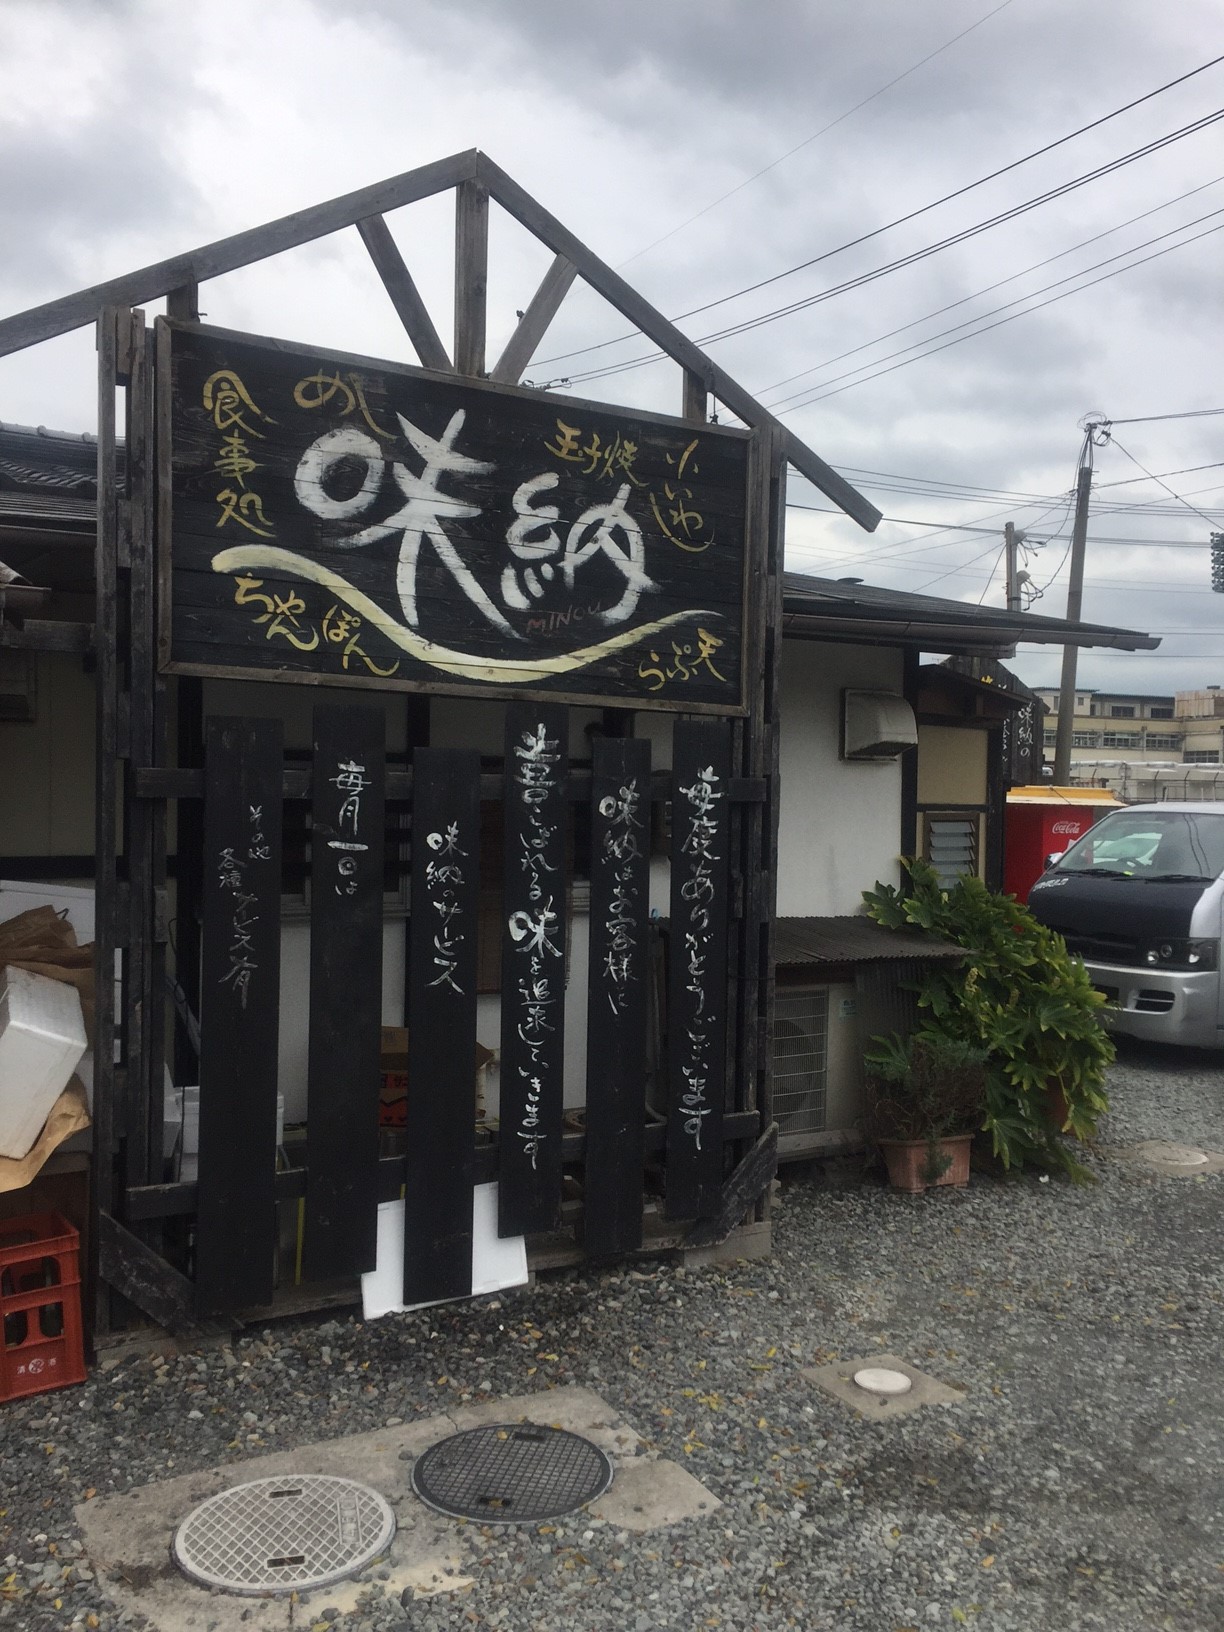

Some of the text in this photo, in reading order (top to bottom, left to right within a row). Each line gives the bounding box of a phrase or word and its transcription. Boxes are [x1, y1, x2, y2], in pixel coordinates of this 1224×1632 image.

[203, 369, 279, 538] 食事処
[293, 368, 399, 443] めし
